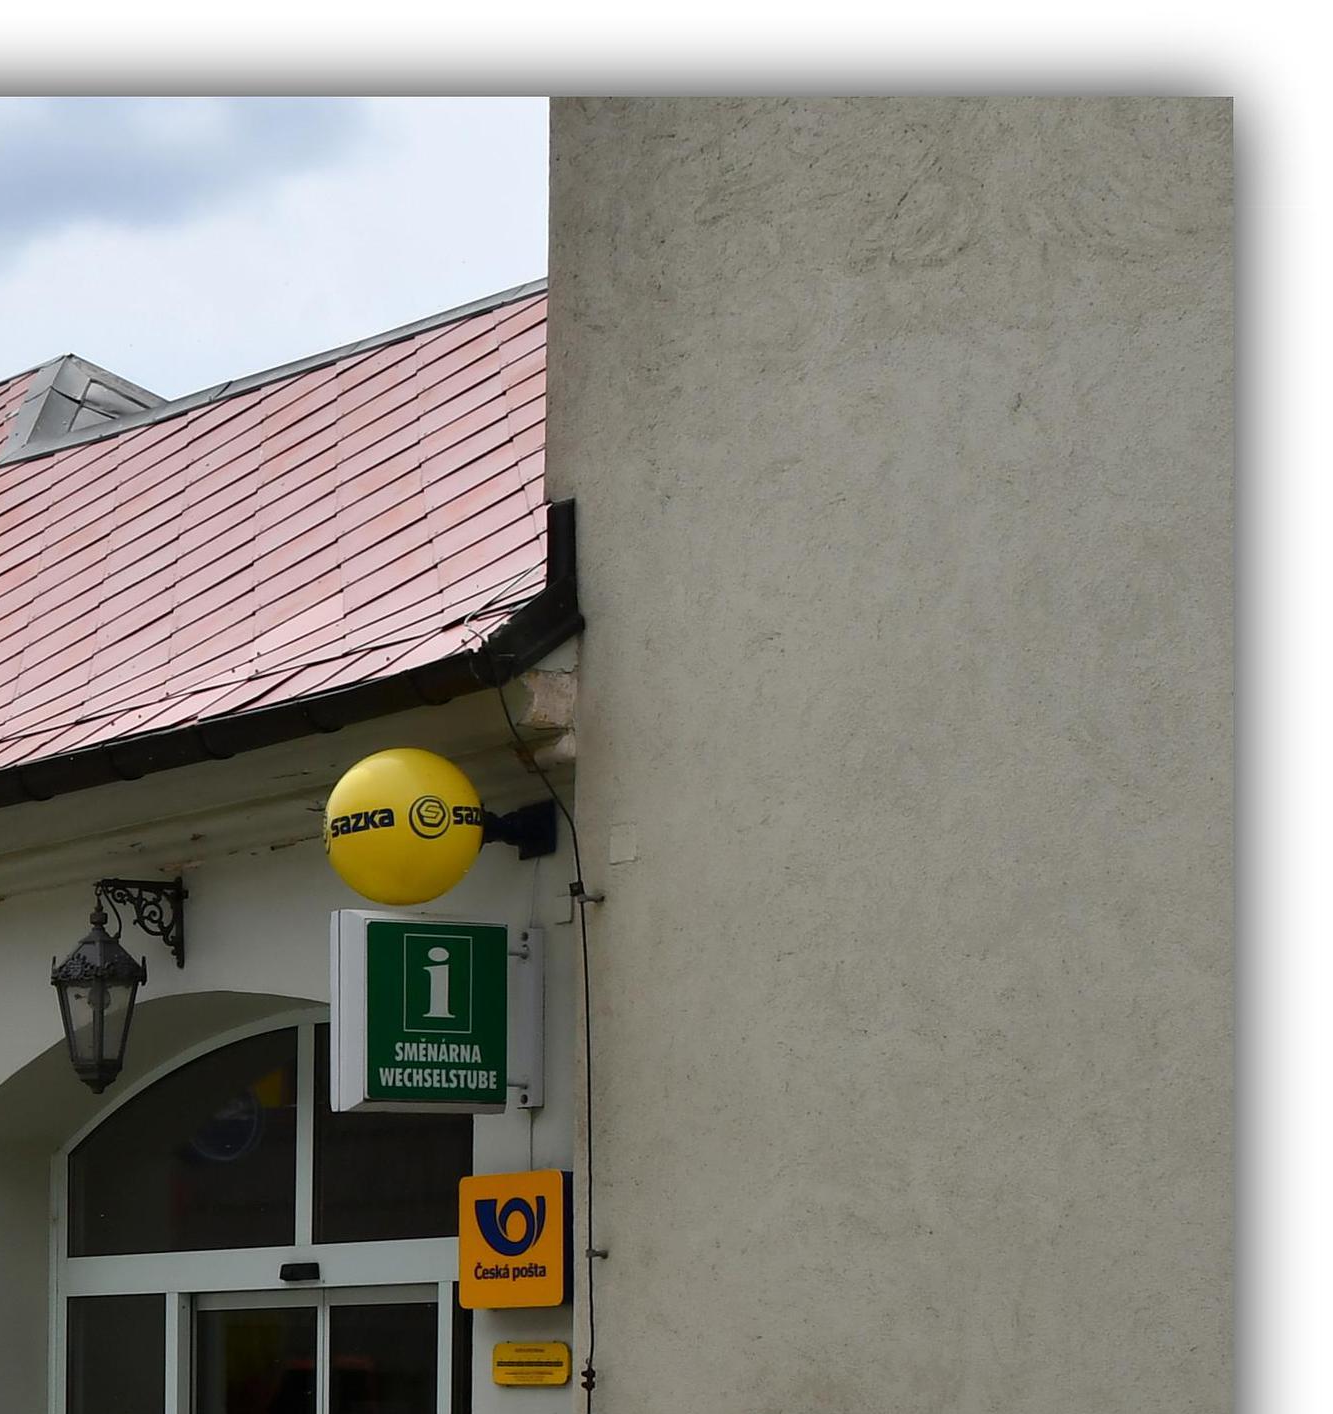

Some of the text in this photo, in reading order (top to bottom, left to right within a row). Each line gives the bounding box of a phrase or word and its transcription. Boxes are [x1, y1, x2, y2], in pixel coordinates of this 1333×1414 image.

[331, 808, 395, 838] sazka
[394, 1038, 482, 1063] SMĚNÁRNA
[379, 1067, 498, 1090] WECHSELSTUBE
[473, 1262, 547, 1282] Česká pošta
